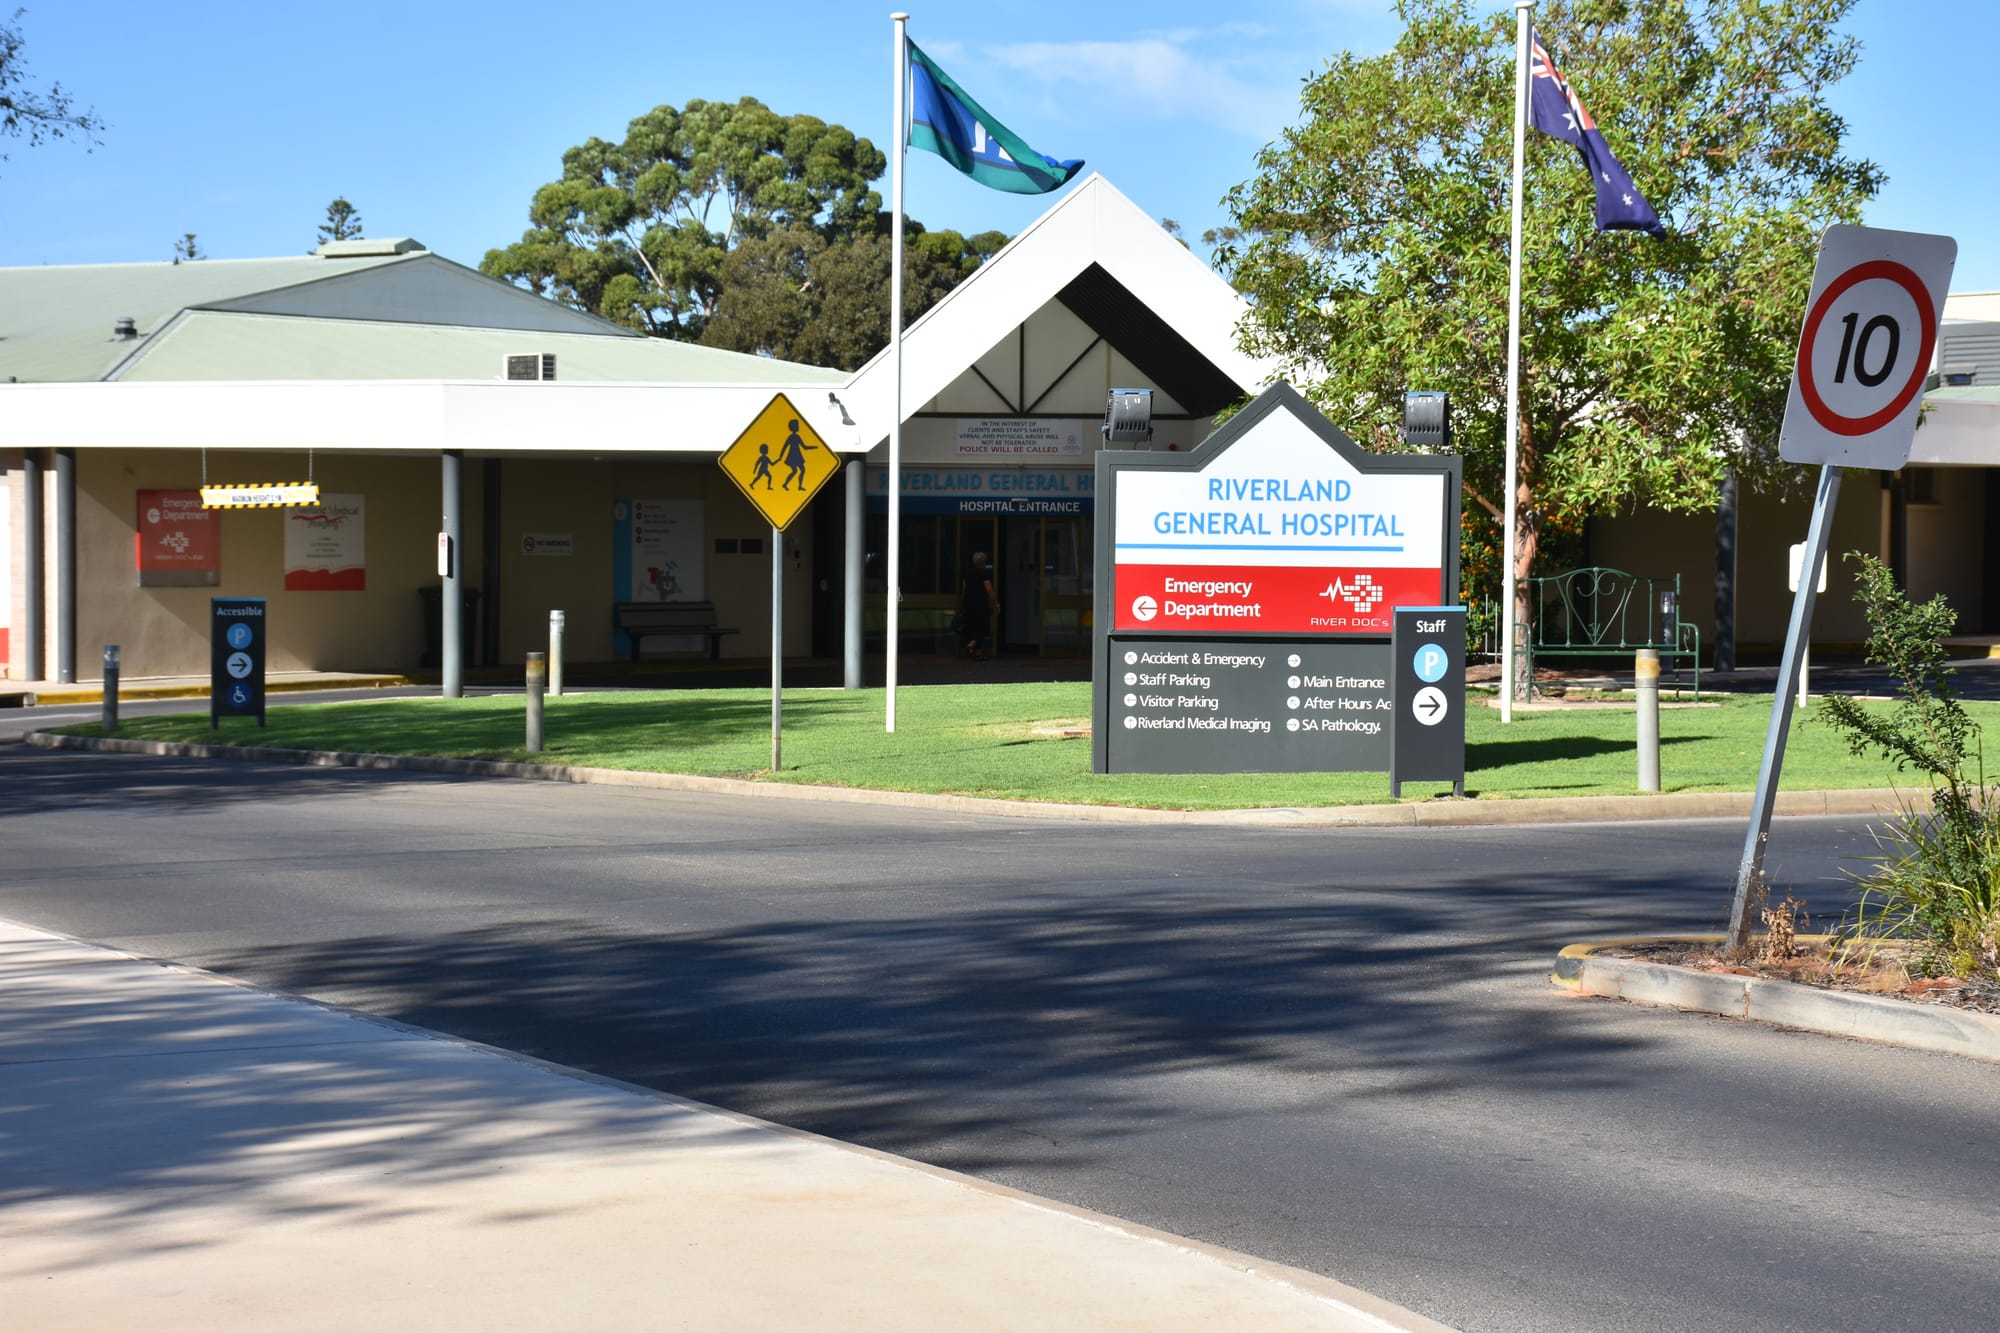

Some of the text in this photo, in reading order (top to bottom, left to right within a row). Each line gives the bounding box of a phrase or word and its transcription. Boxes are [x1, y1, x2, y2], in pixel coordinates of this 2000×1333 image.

[1834, 312, 1900, 387] 10
[879, 471, 982, 490] RVERLAND
[989, 471, 1069, 491] GENERAL
[1208, 477, 1351, 502] RIVERLAND
[162, 498, 202, 509] Emergenc
[960, 501, 1080, 512] HOSPITAL ENTRANCE
[1153, 510, 1404, 538] GENERAL HOSPITAL
[1164, 577, 1252, 597] Emergency
[217, 606, 263, 616] Accessible
[1164, 600, 1261, 620] Department
[1310, 617, 1389, 627] RIVER DOC's
[1416, 619, 1446, 633] Staff
[234, 627, 246, 646] P
[1140, 652, 1265, 669] Accident & Emergency
[1424, 651, 1439, 676] P
[1139, 673, 1210, 689] Staff Parking
[1303, 675, 1385, 689] Main Entrance
[1139, 694, 1218, 711] Visitor Parking
[1303, 696, 1392, 710] After Hours Ac
[1138, 716, 1271, 733] Riverland Medical Imaging
[1302, 719, 1381, 735] SA Pathology.
